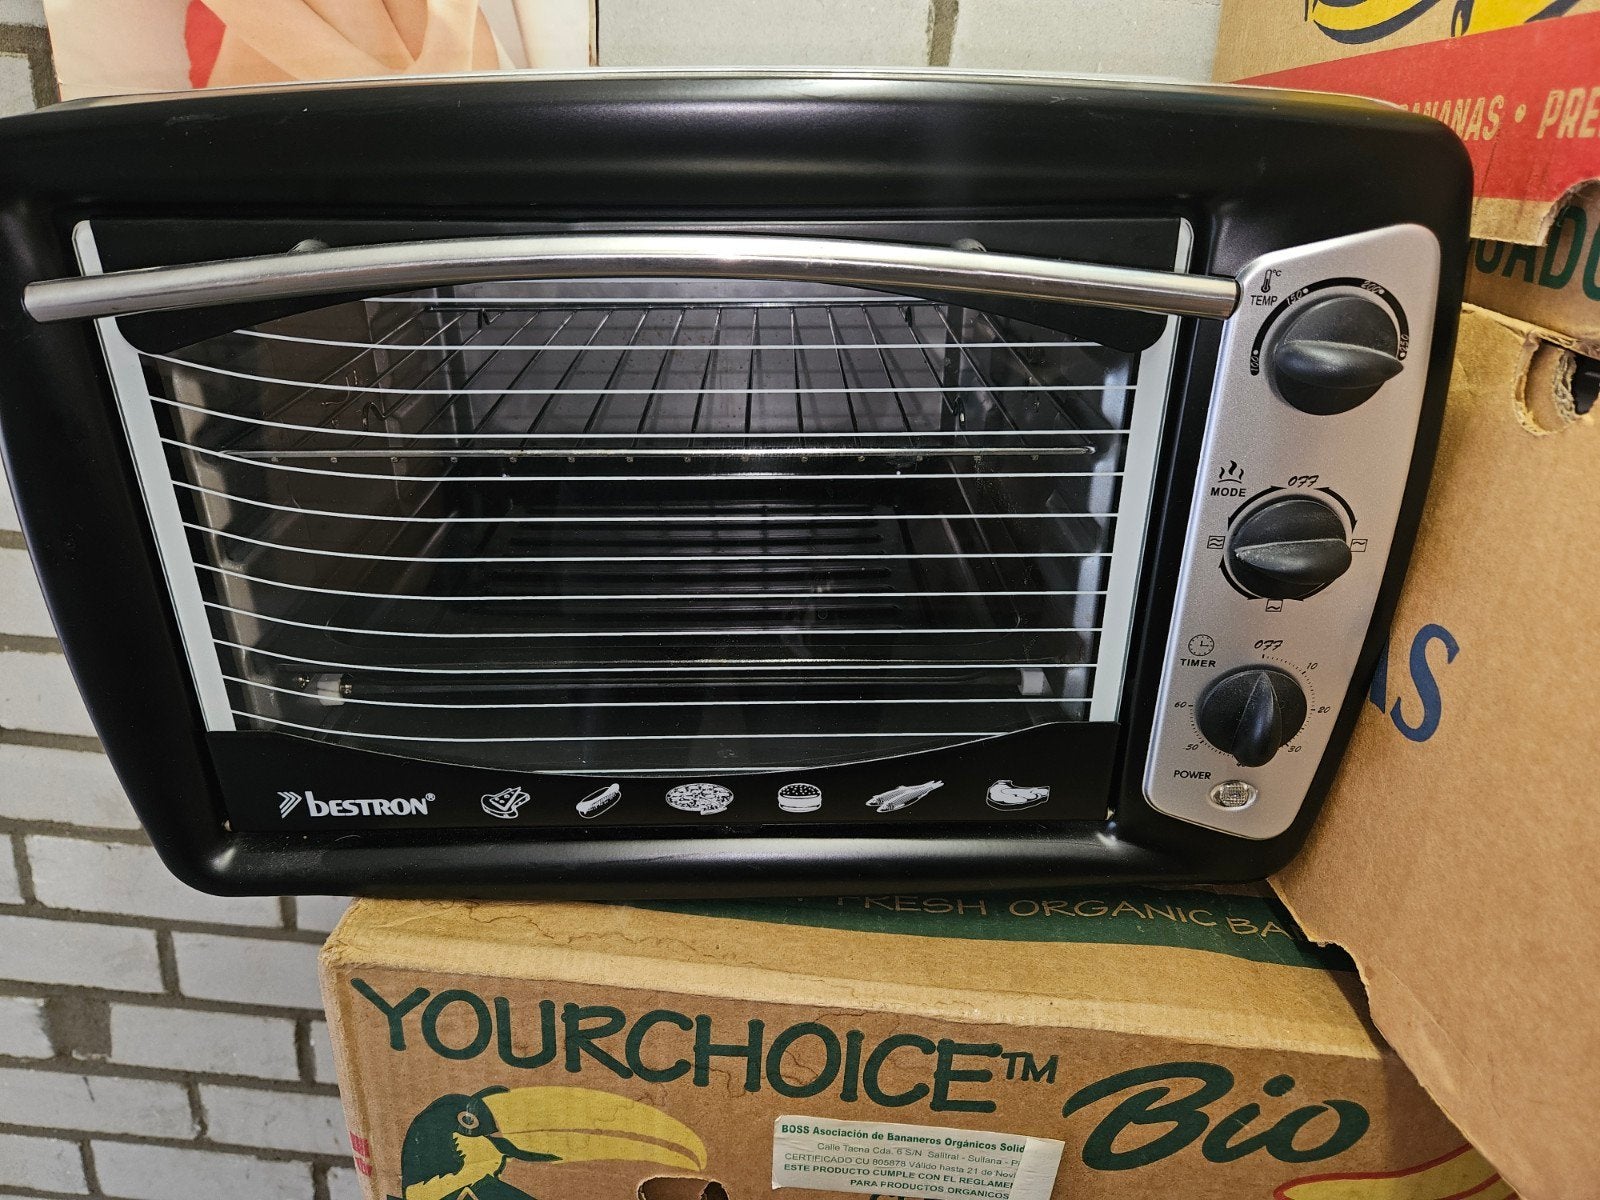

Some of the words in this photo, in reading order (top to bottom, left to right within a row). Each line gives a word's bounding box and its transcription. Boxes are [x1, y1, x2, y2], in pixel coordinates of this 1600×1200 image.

[1360, 279, 1381, 294] 200
[1250, 294, 1278, 306] TEMP
[1286, 290, 1304, 306] 150
[1400, 334, 1410, 352] 250
[1250, 355, 1260, 373] 100
[1287, 474, 1320, 488] OFF
[1210, 486, 1247, 498] MODE
[1254, 639, 1284, 651] OFF
[1179, 658, 1217, 668] TIMER
[1306, 662, 1318, 671] 10
[1317, 706, 1331, 714] 20
[1184, 743, 1199, 751] 50
[1287, 745, 1302, 753] 30
[1173, 770, 1212, 780] POWER
[1008, 899, 1217, 928] ORGANIC
[1062, 1061, 1371, 1172] Bio
[781, 1124, 810, 1134] BOSS
[812, 1126, 869, 1139] Asociación
[871, 1131, 884, 1140] de
[887, 1132, 942, 1145] Bananeros
[944, 1137, 997, 1151] Orgánicos
[817, 1142, 840, 1152] Calle
[843, 1145, 870, 1154] Tacna
[872, 1146, 893, 1155] Cda.
[905, 1148, 922, 1157] S/N
[784, 1153, 853, 1164] CERTIFICADO
[855, 1157, 870, 1165] CU
[872, 1158, 906, 1168] 805878
[908, 1161, 937, 1170] Válido
[939, 1164, 965, 1174] hasta
[966, 1167, 978, 1175] 21
[981, 1168, 992, 1177] de
[783, 1164, 811, 1172] ESTE
[812, 1165, 871, 1176] PRODUCTO
[872, 1169, 917, 1180] CUMPLE
[918, 1172, 941, 1181] CON
[943, 1175, 957, 1183] EL
[850, 1179, 878, 1188] PARA
[880, 1180, 945, 1193] PRODUCTOS
[947, 1186, 1010, 1200] ORGANICOS
